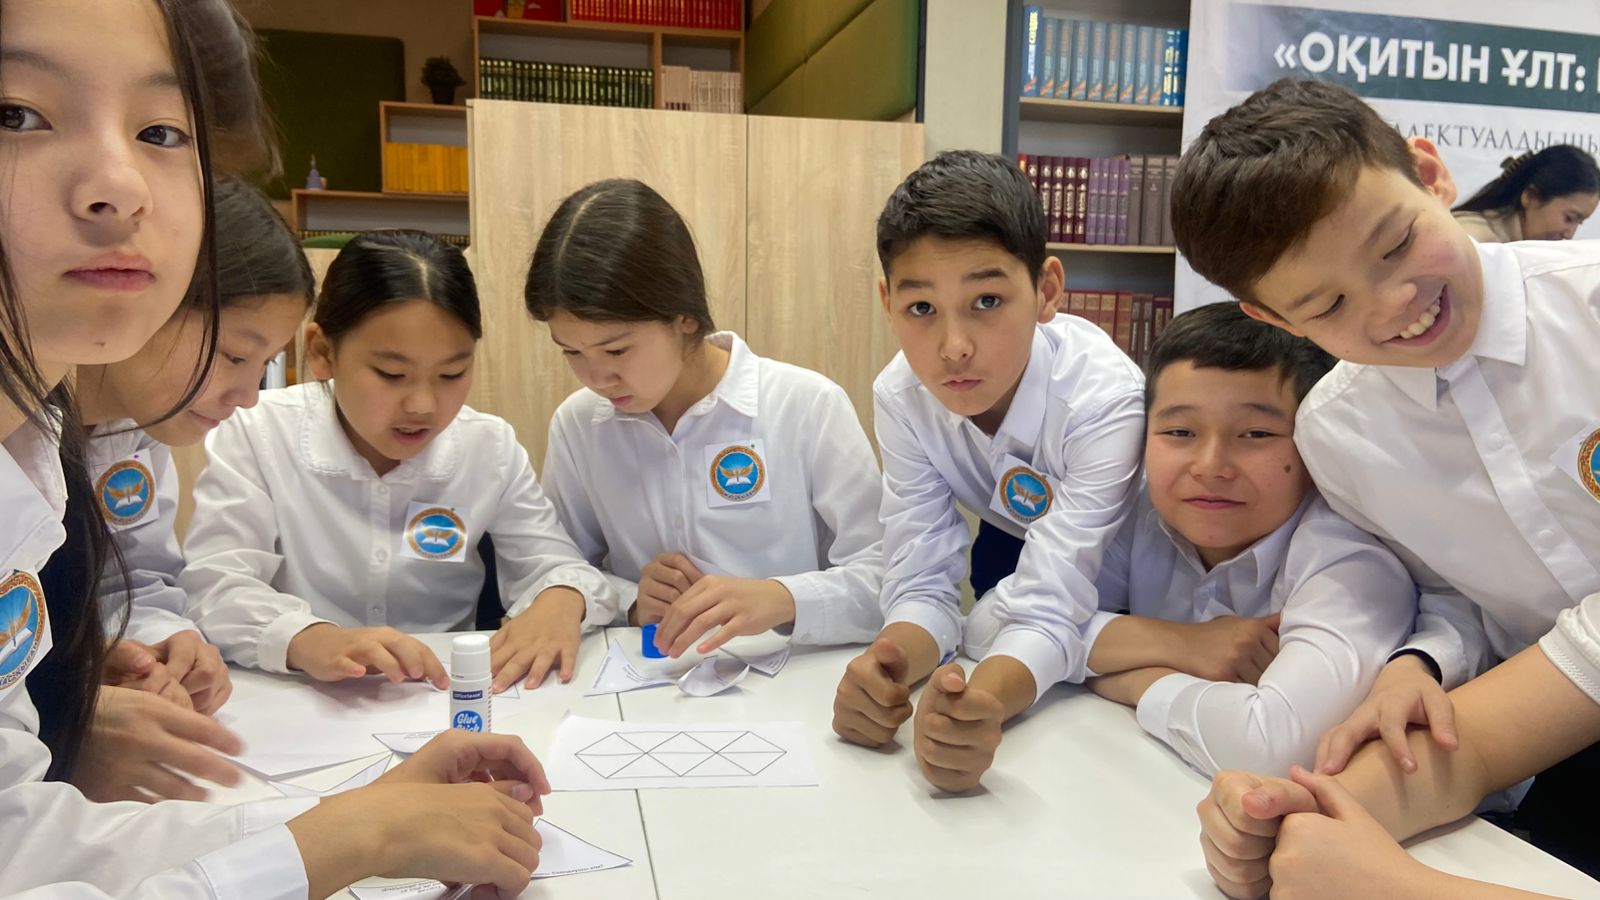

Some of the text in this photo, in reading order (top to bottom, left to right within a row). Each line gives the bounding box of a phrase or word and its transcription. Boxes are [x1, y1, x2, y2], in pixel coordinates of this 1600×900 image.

[1273, 31, 1490, 84] «ОҚИТЫН
[1500, 48, 1586, 93] ҰЛТ:
[457, 713, 478, 724] Glue
